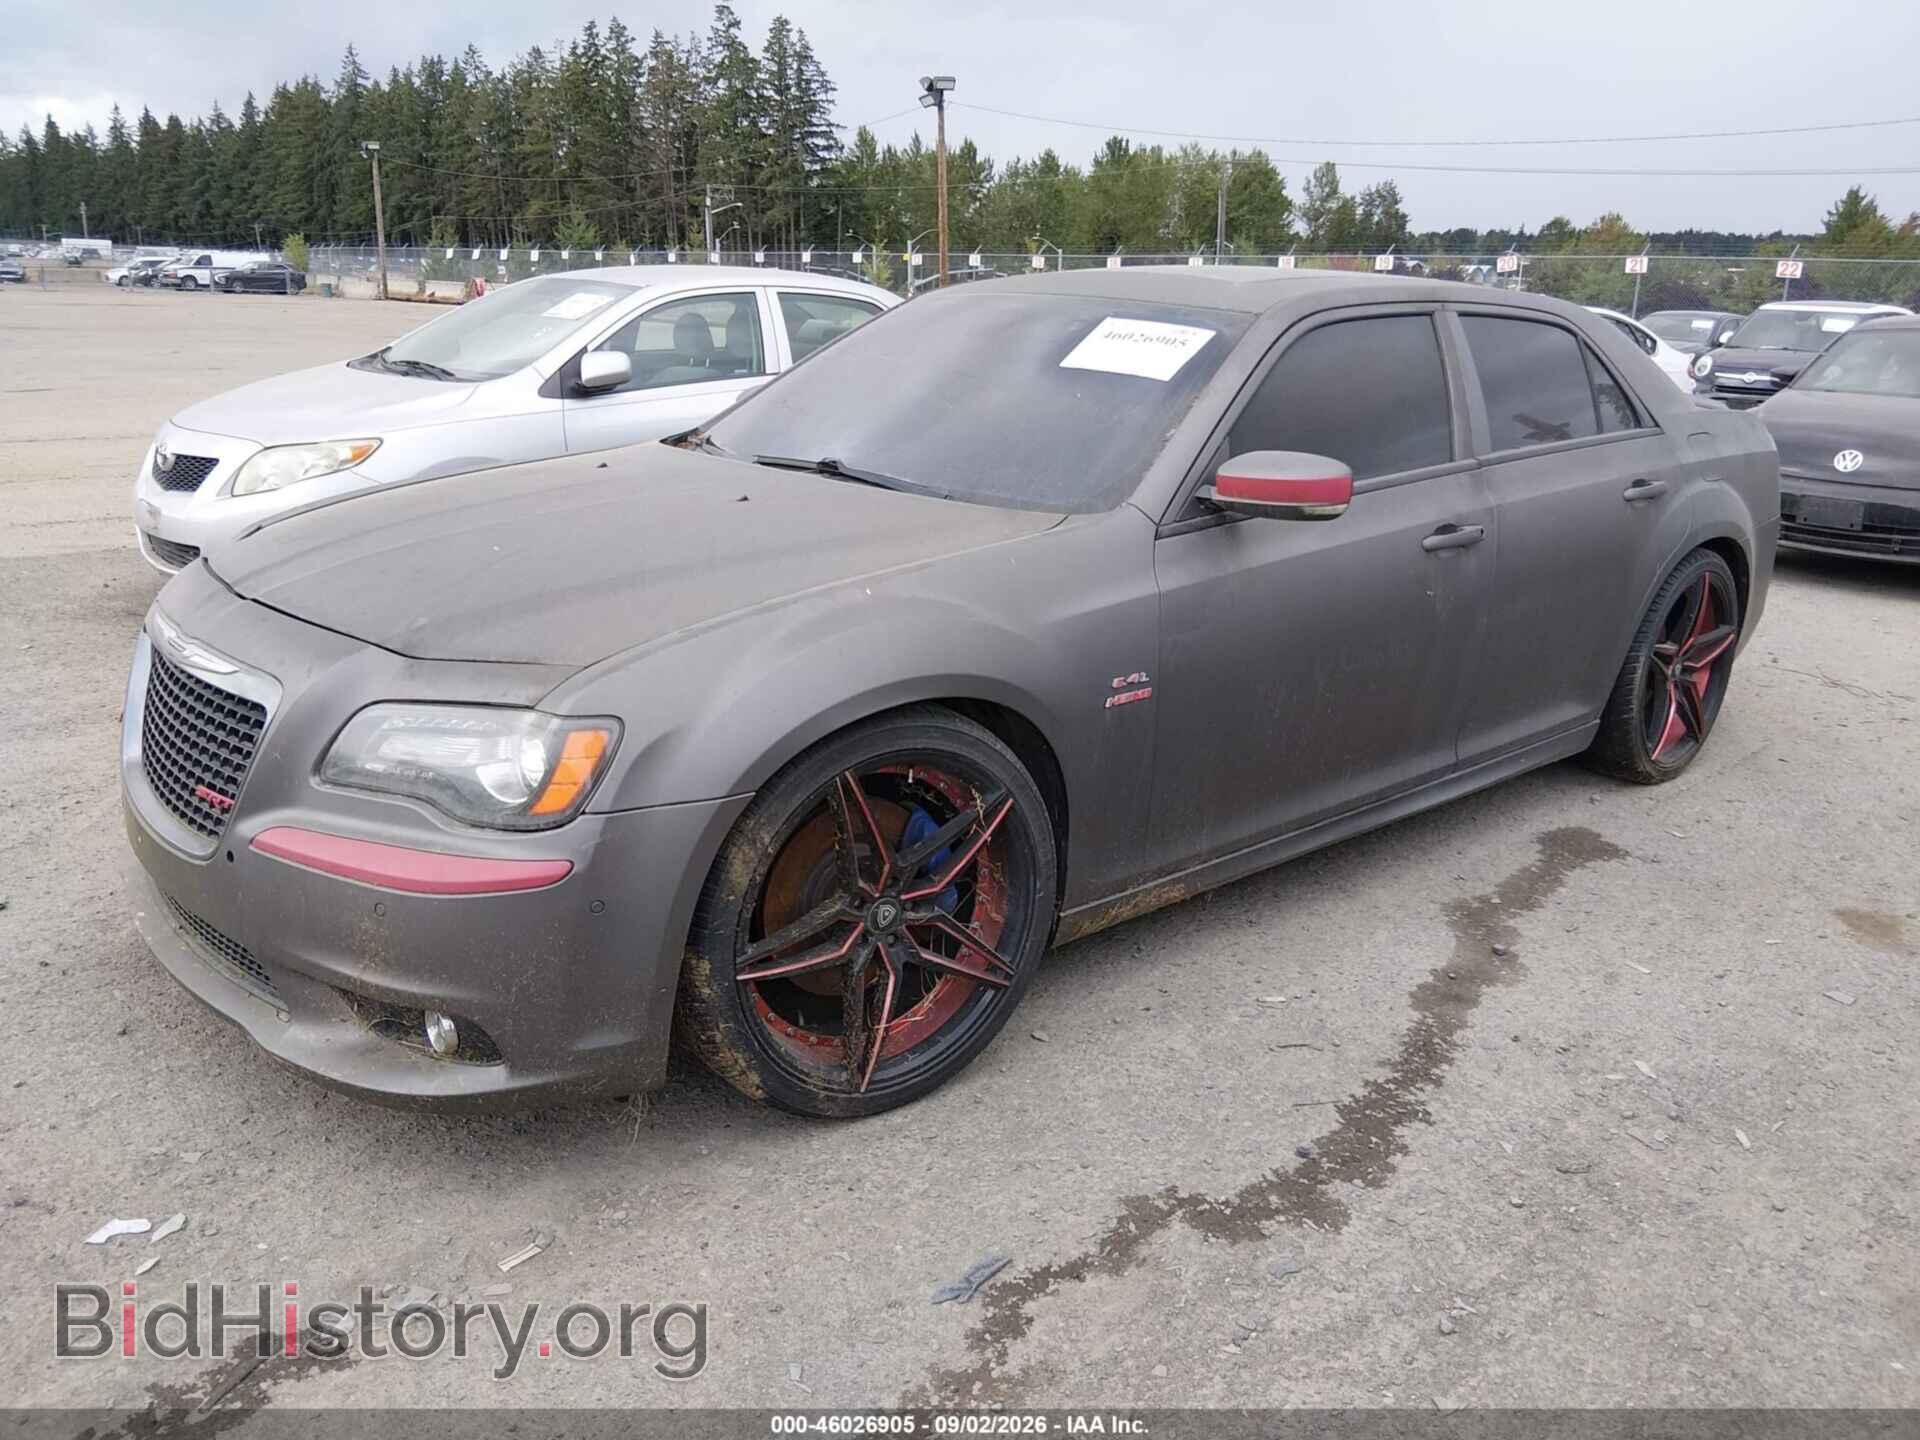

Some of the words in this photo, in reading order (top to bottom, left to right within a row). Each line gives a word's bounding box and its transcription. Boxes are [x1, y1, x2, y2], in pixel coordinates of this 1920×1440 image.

[1499, 257, 1515, 271] 20
[1630, 258, 1643, 272] 21
[1780, 262, 1799, 276] 22
